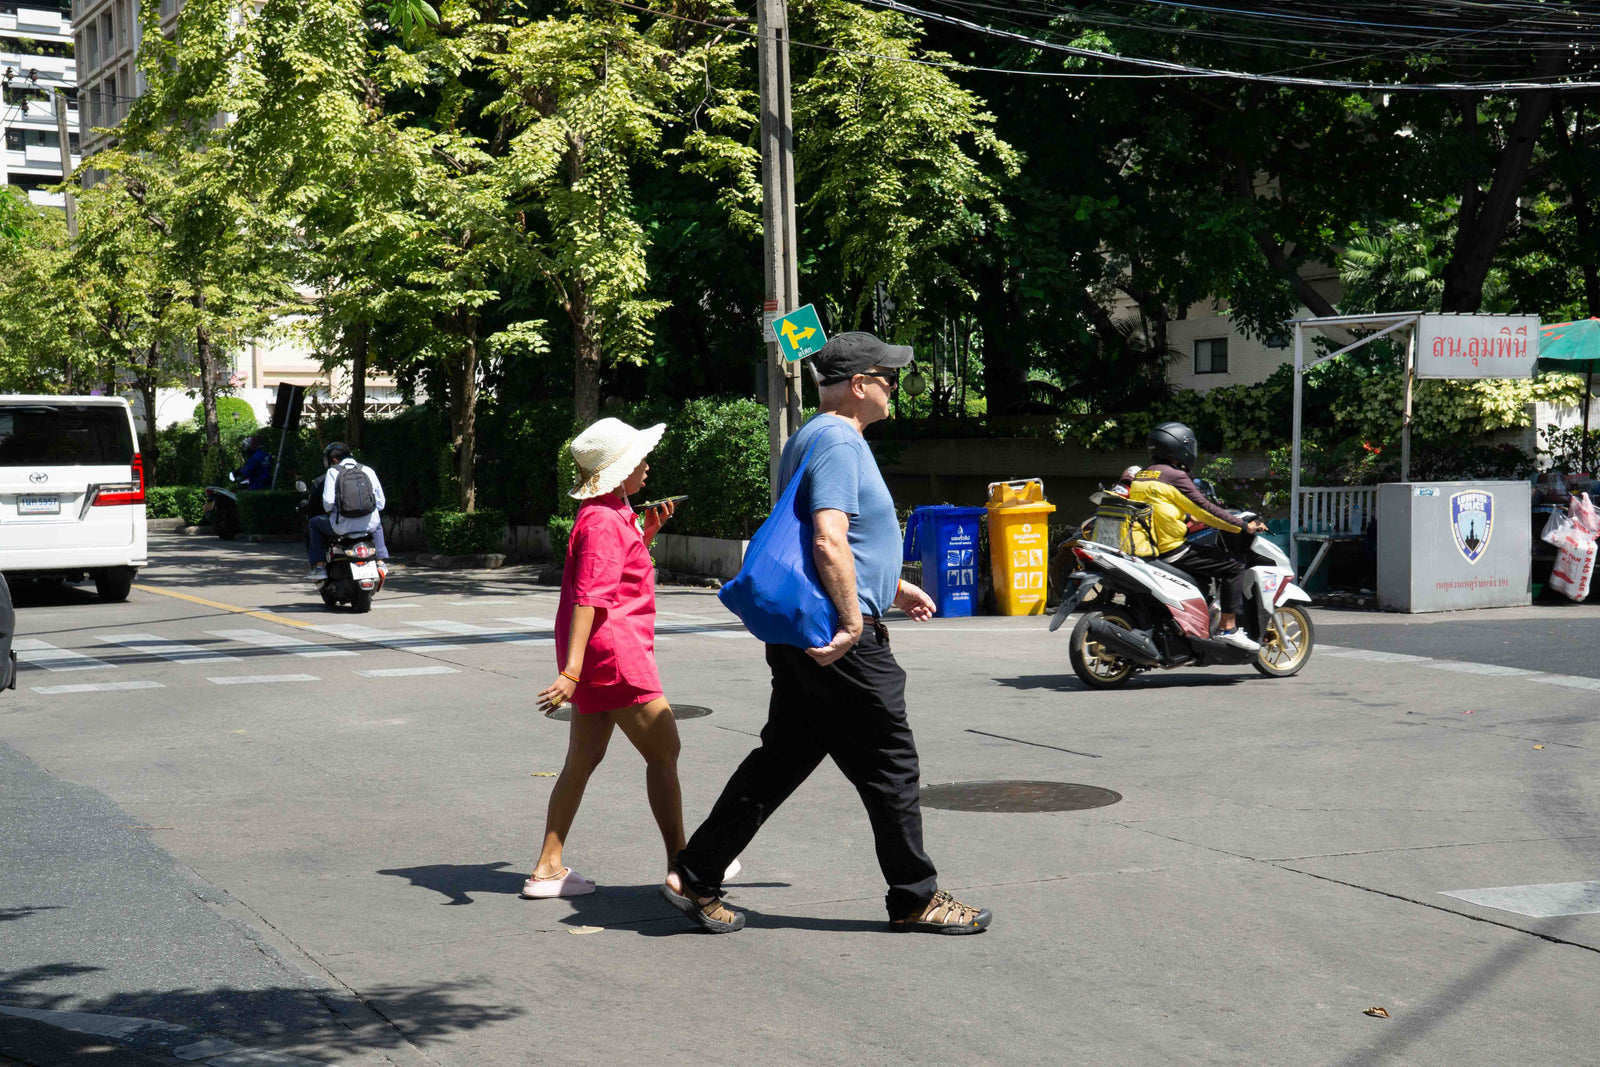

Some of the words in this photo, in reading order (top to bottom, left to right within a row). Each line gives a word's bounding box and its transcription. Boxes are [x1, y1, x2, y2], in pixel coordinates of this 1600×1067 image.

[1432, 325, 1527, 368] สน.ลุมพินี
[1457, 493, 1487, 505] LUMPINI
[1459, 501, 1485, 511] POLICE
[1498, 578, 1509, 587] 191
